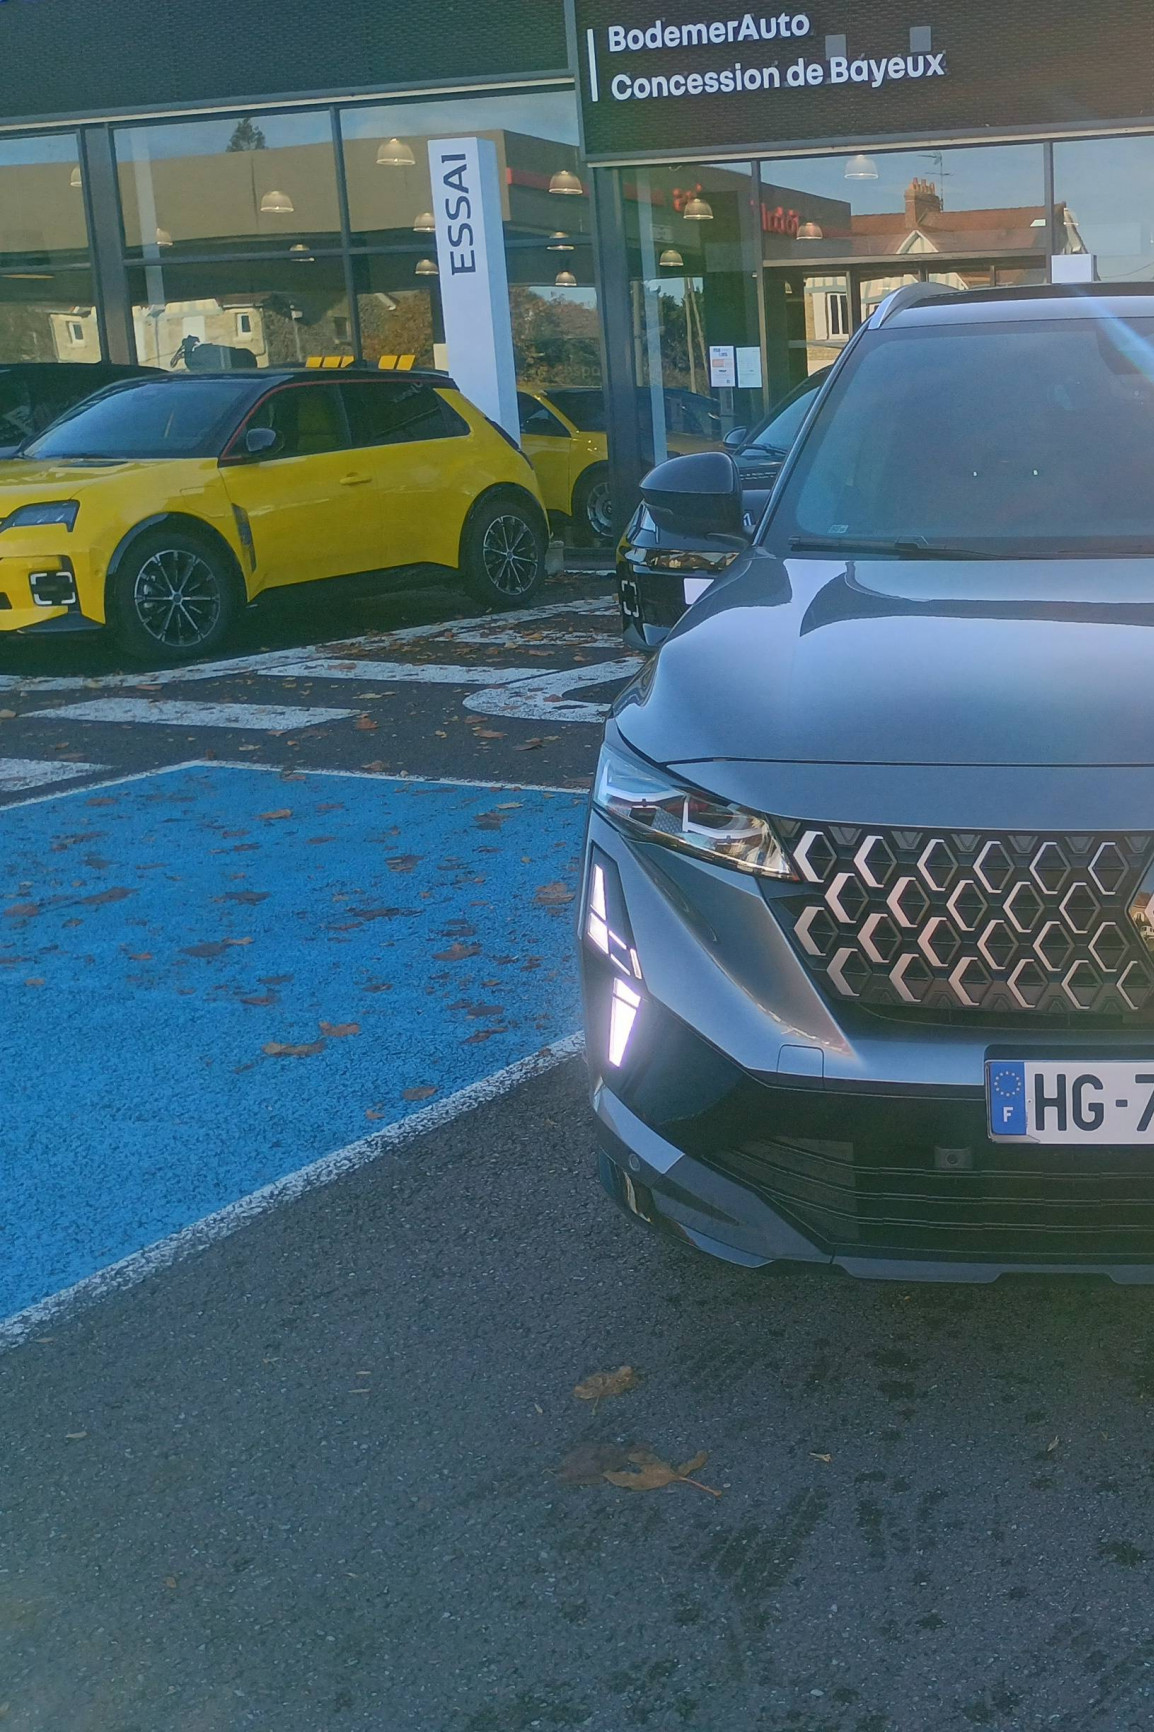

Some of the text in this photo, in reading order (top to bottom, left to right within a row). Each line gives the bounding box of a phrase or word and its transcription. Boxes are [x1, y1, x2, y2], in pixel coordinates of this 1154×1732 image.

[608, 12, 811, 52] BodemerAuto
[611, 52, 945, 101] Concession de Bayeux
[440, 153, 477, 276] ESSAI
[1002, 1106, 1014, 1123] F
